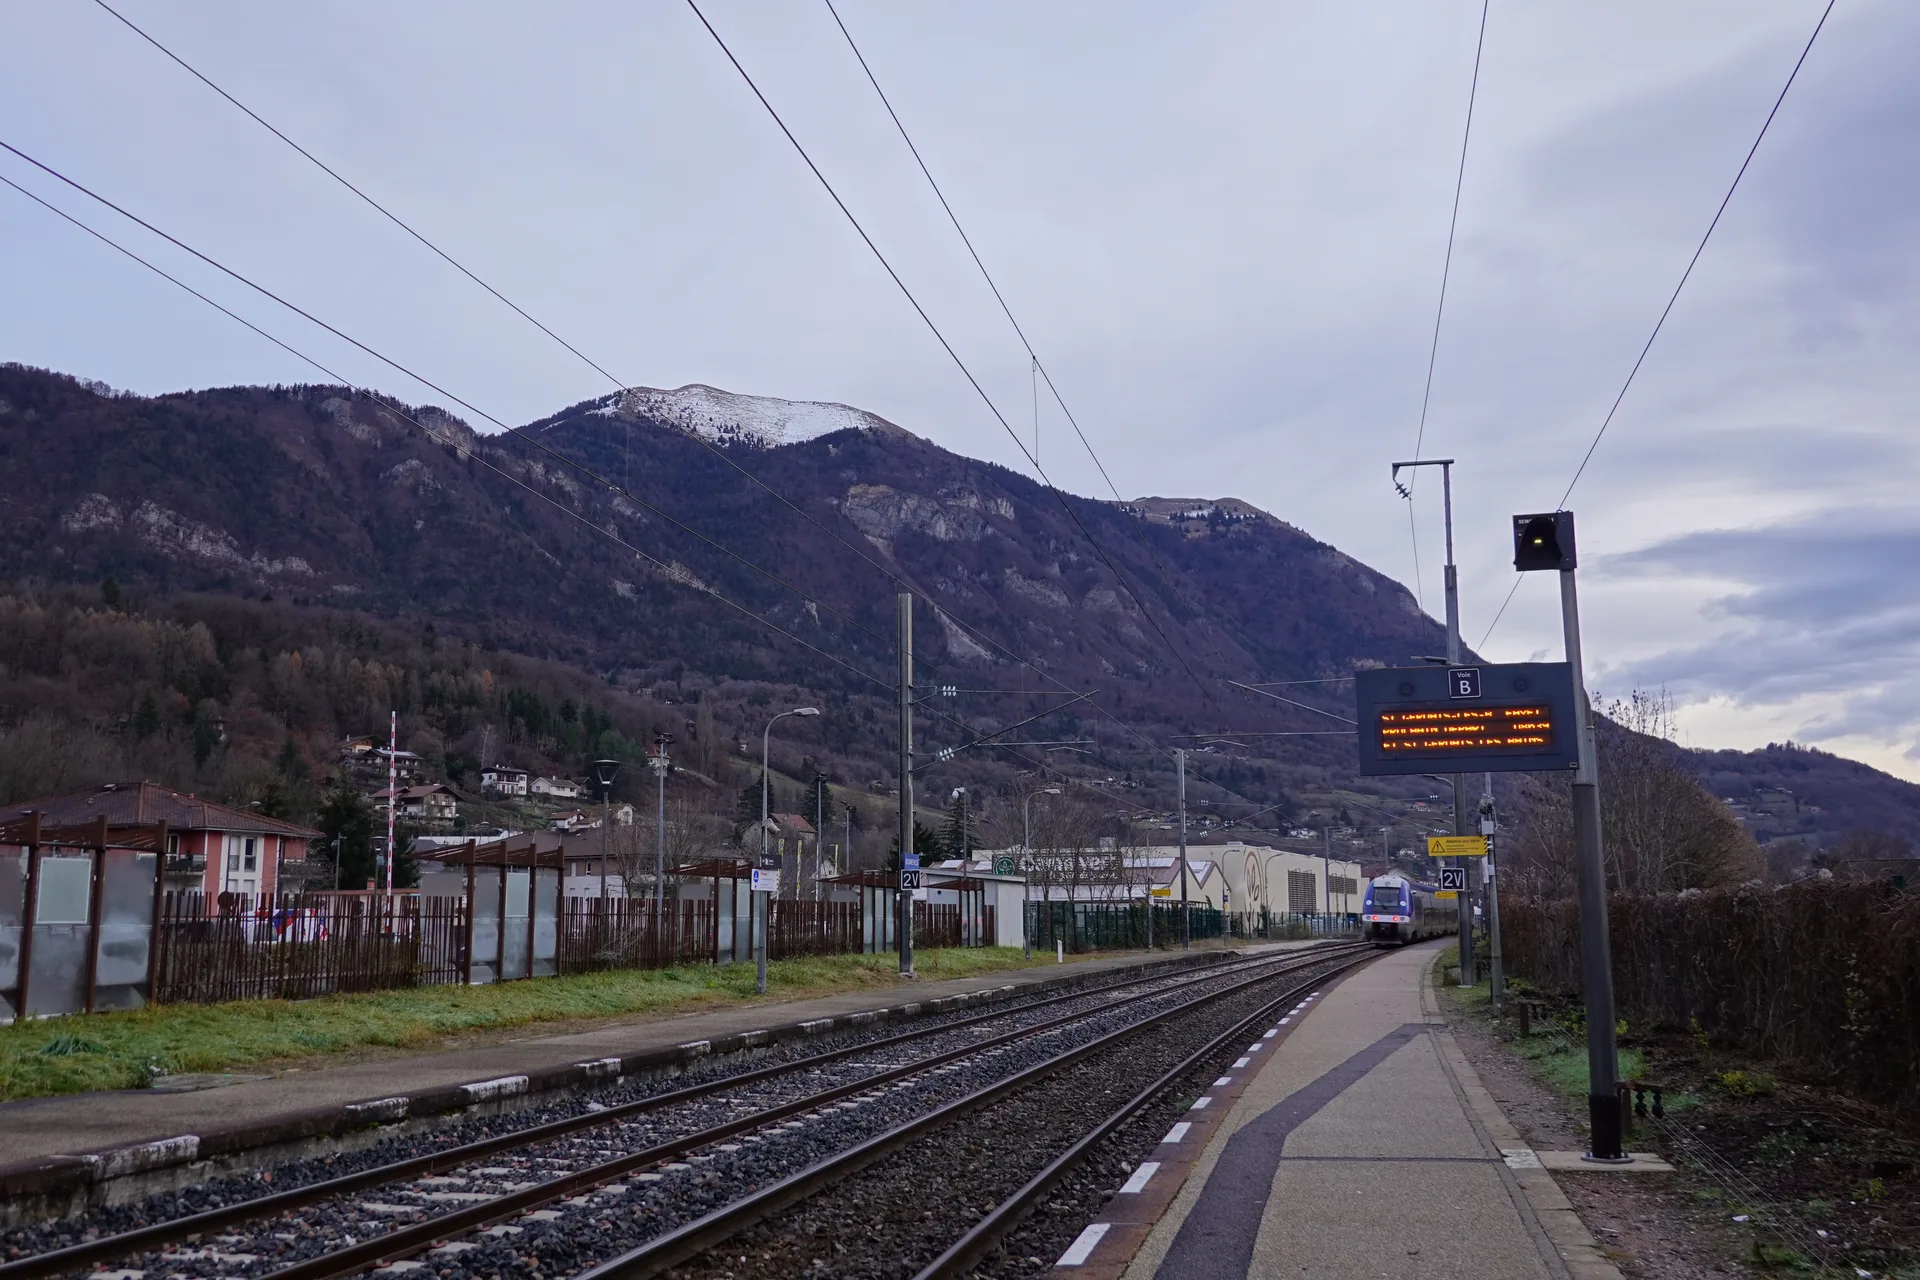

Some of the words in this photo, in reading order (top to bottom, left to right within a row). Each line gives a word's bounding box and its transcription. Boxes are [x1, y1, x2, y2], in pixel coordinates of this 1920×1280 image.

[1460, 680, 1471, 695] B
[903, 873, 919, 887] 2V
[1443, 872, 1462, 887] 2V
